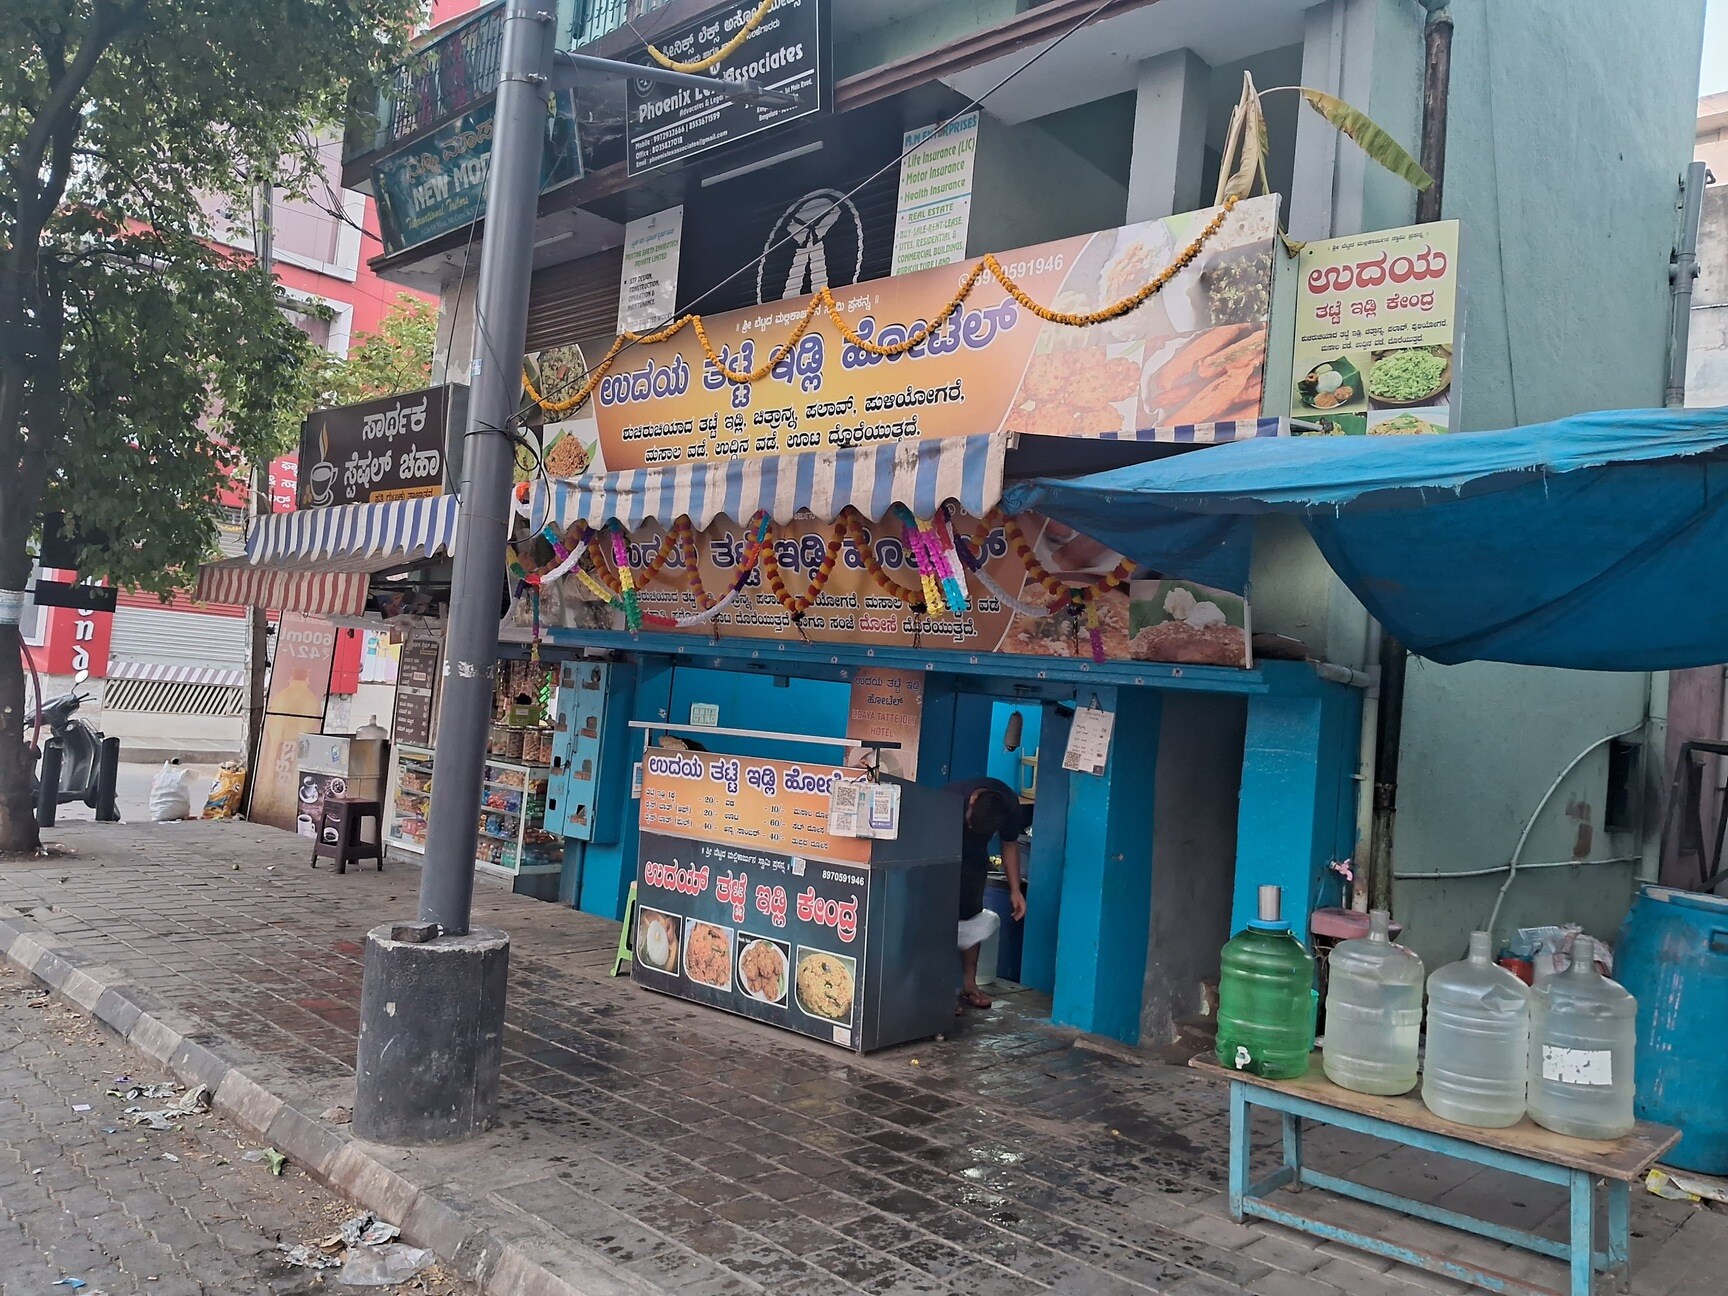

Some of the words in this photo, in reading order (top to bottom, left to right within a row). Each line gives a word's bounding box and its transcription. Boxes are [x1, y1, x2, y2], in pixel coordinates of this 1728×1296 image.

[639, 88, 692, 123] Phoenix
[725, 43, 804, 84] Associates
[907, 155, 921, 168] Life
[923, 144, 956, 164] Insurance
[958, 137, 975, 156] (LIC)
[906, 170, 928, 186] Motor
[930, 160, 965, 177] Insurance
[412, 173, 449, 212] NEW
[904, 186, 928, 202] Health
[930, 179, 966, 194] Insurance
[908, 210, 926, 221] REAL
[928, 203, 954, 217] ESTATE
[916, 232, 950, 247] RESIDENTIAL
[898, 247, 932, 263] COMMERCIAL
[1307, 243, 1448, 294] ಉದಯ
[1315, 300, 1342, 325] ತಟ್ಟೆ
[1350, 298, 1377, 318] ಇಡ್ಲಿ
[1386, 289, 1435, 312] ಕೇಂದ್ರ
[600, 353, 690, 407] ಉದಯ
[703, 338, 754, 409] ತಟ್ಟೆ
[771, 332, 825, 394] ಇಡ್ಲಿ
[841, 296, 1019, 371] ಹೋಟೆಲ್
[362, 396, 427, 442] ಸಾರ್ಥಕ
[699, 412, 718, 439] ತಟ್ಟೆ
[645, 445, 682, 464] ಮಸಾಲ
[787, 430, 820, 448] ಊಟ
[344, 450, 392, 498] ಸ್ಪೆಷಲ್
[400, 443, 440, 479] ಚಹಾ
[865, 596, 903, 610] ಮಸಾಲ
[830, 615, 855, 630] ಸಂಜೆ
[859, 615, 898, 632] ದೋಸೆ
[867, 693, 904, 706] ಹೋಟೆಲ್
[852, 709, 875, 720] UDAYA
[877, 712, 899, 723] TATTE
[870, 726, 894, 738] HOTEL
[649, 753, 703, 779] ಉದಯ
[709, 758, 739, 794] ತಟ್ಟೆ
[747, 766, 777, 797] ಇಡ್ಲಿ
[822, 869, 865, 886] 8970591946
[716, 869, 748, 923] ತಟ್ಟೆ
[755, 885, 788, 928] ಇಡ್ಲಿ
[796, 885, 859, 943] ಕೇಂದ್ರ
